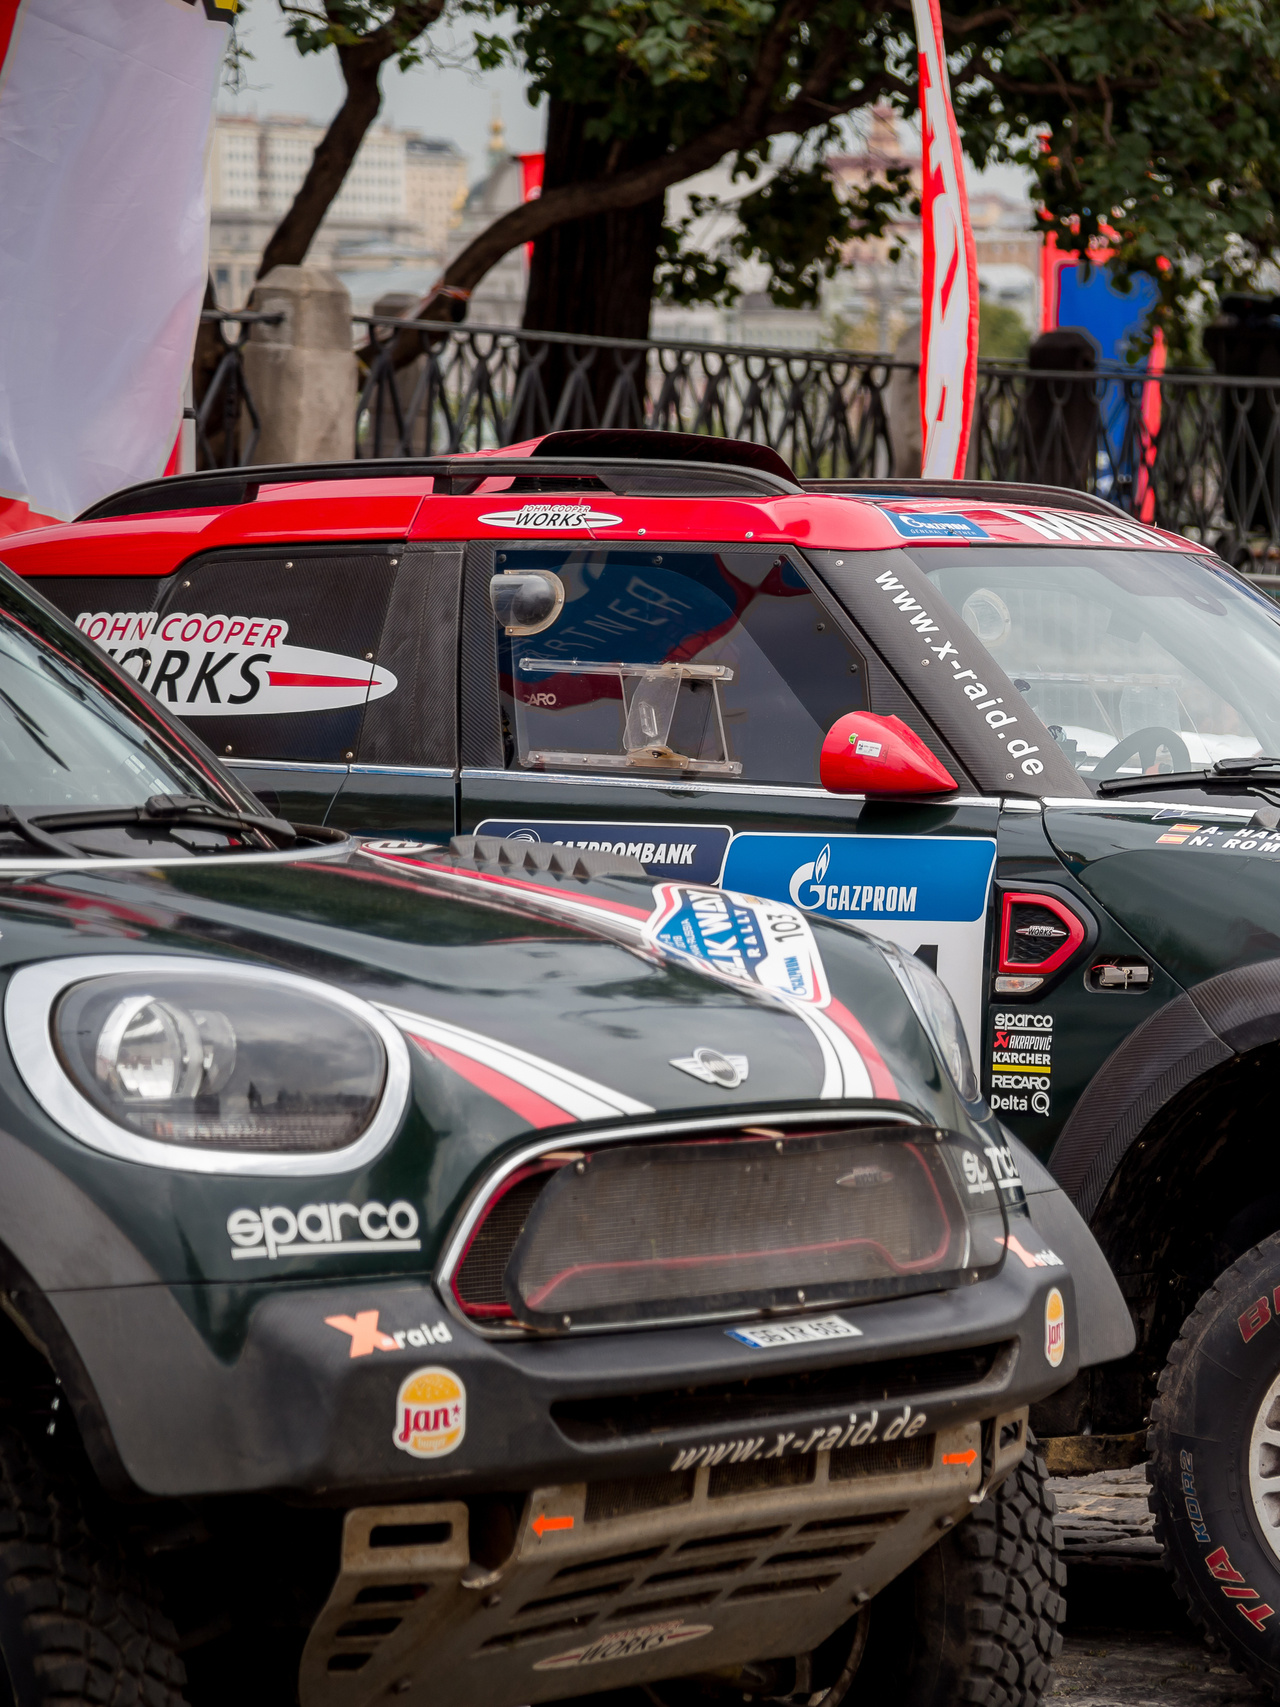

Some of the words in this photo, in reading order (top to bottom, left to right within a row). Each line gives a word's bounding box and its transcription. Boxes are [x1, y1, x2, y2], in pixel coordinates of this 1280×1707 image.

[515, 513, 587, 527] WORKS
[520, 504, 550, 513] JOHN
[551, 505, 590, 513] COOPER
[909, 528, 944, 536] GENERAL
[944, 529, 978, 537] PRTNER
[988, 508, 1181, 549] MINI
[77, 617, 153, 642] JOHN
[161, 616, 284, 649] COOPER
[874, 569, 1045, 777] www.x-raid.de
[1188, 834, 1214, 848] N.
[1200, 825, 1224, 836] A.
[825, 884, 918, 912] GAZPROM
[686, 889, 733, 937] WAY
[734, 909, 763, 958] RALLY
[766, 913, 805, 944] 103
[994, 1012, 1054, 1031] sparco
[1008, 1035, 1053, 1051] AKRAPOVIČ
[992, 1051, 1051, 1066] KÄRCHER
[991, 1074, 1051, 1091] RECARO
[990, 1094, 1029, 1112] Delta
[226, 1200, 420, 1259] sparco
[323, 1309, 453, 1359] X-raid
[670, 1404, 927, 1472] www.x-raid.de
[1204, 1545, 1276, 1632] T/A
[578, 1629, 674, 1664] WORKS
